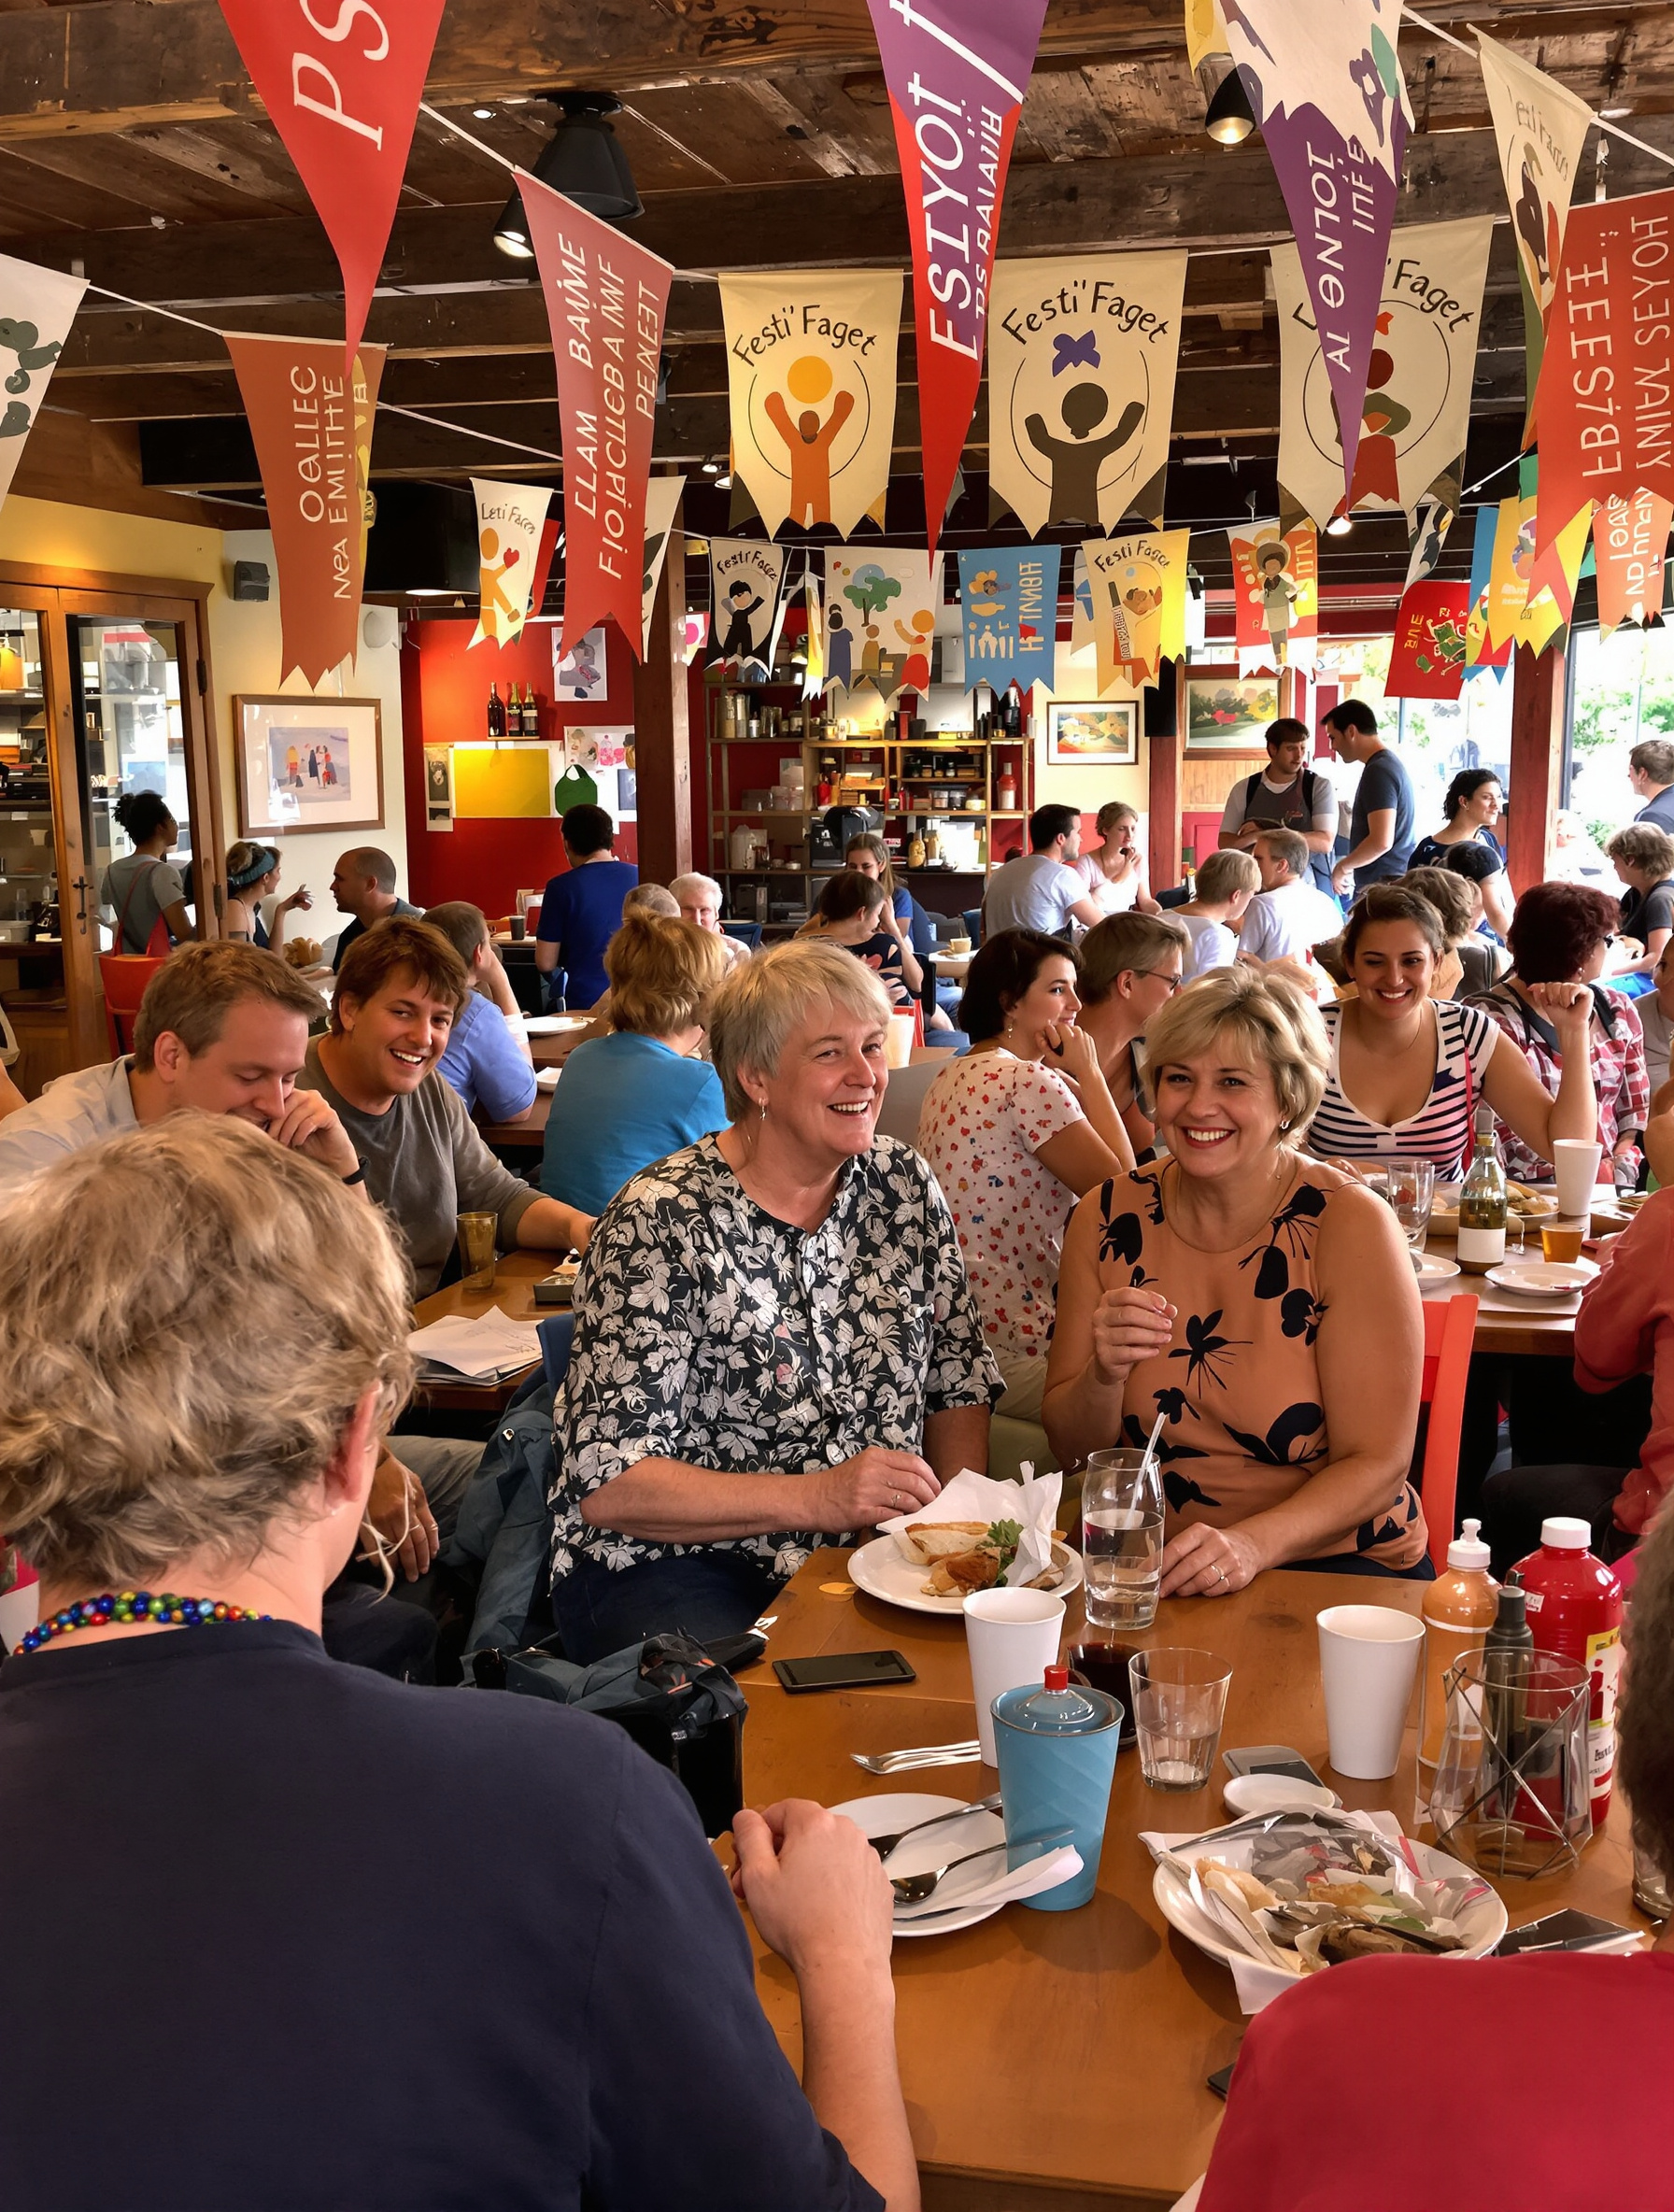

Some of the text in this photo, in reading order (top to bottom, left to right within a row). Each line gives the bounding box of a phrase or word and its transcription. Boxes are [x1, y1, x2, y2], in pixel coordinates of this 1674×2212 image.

[1090, 281, 1170, 344] Faget
[1392, 259, 1475, 333] Faget
[802, 304, 877, 356] Faget
